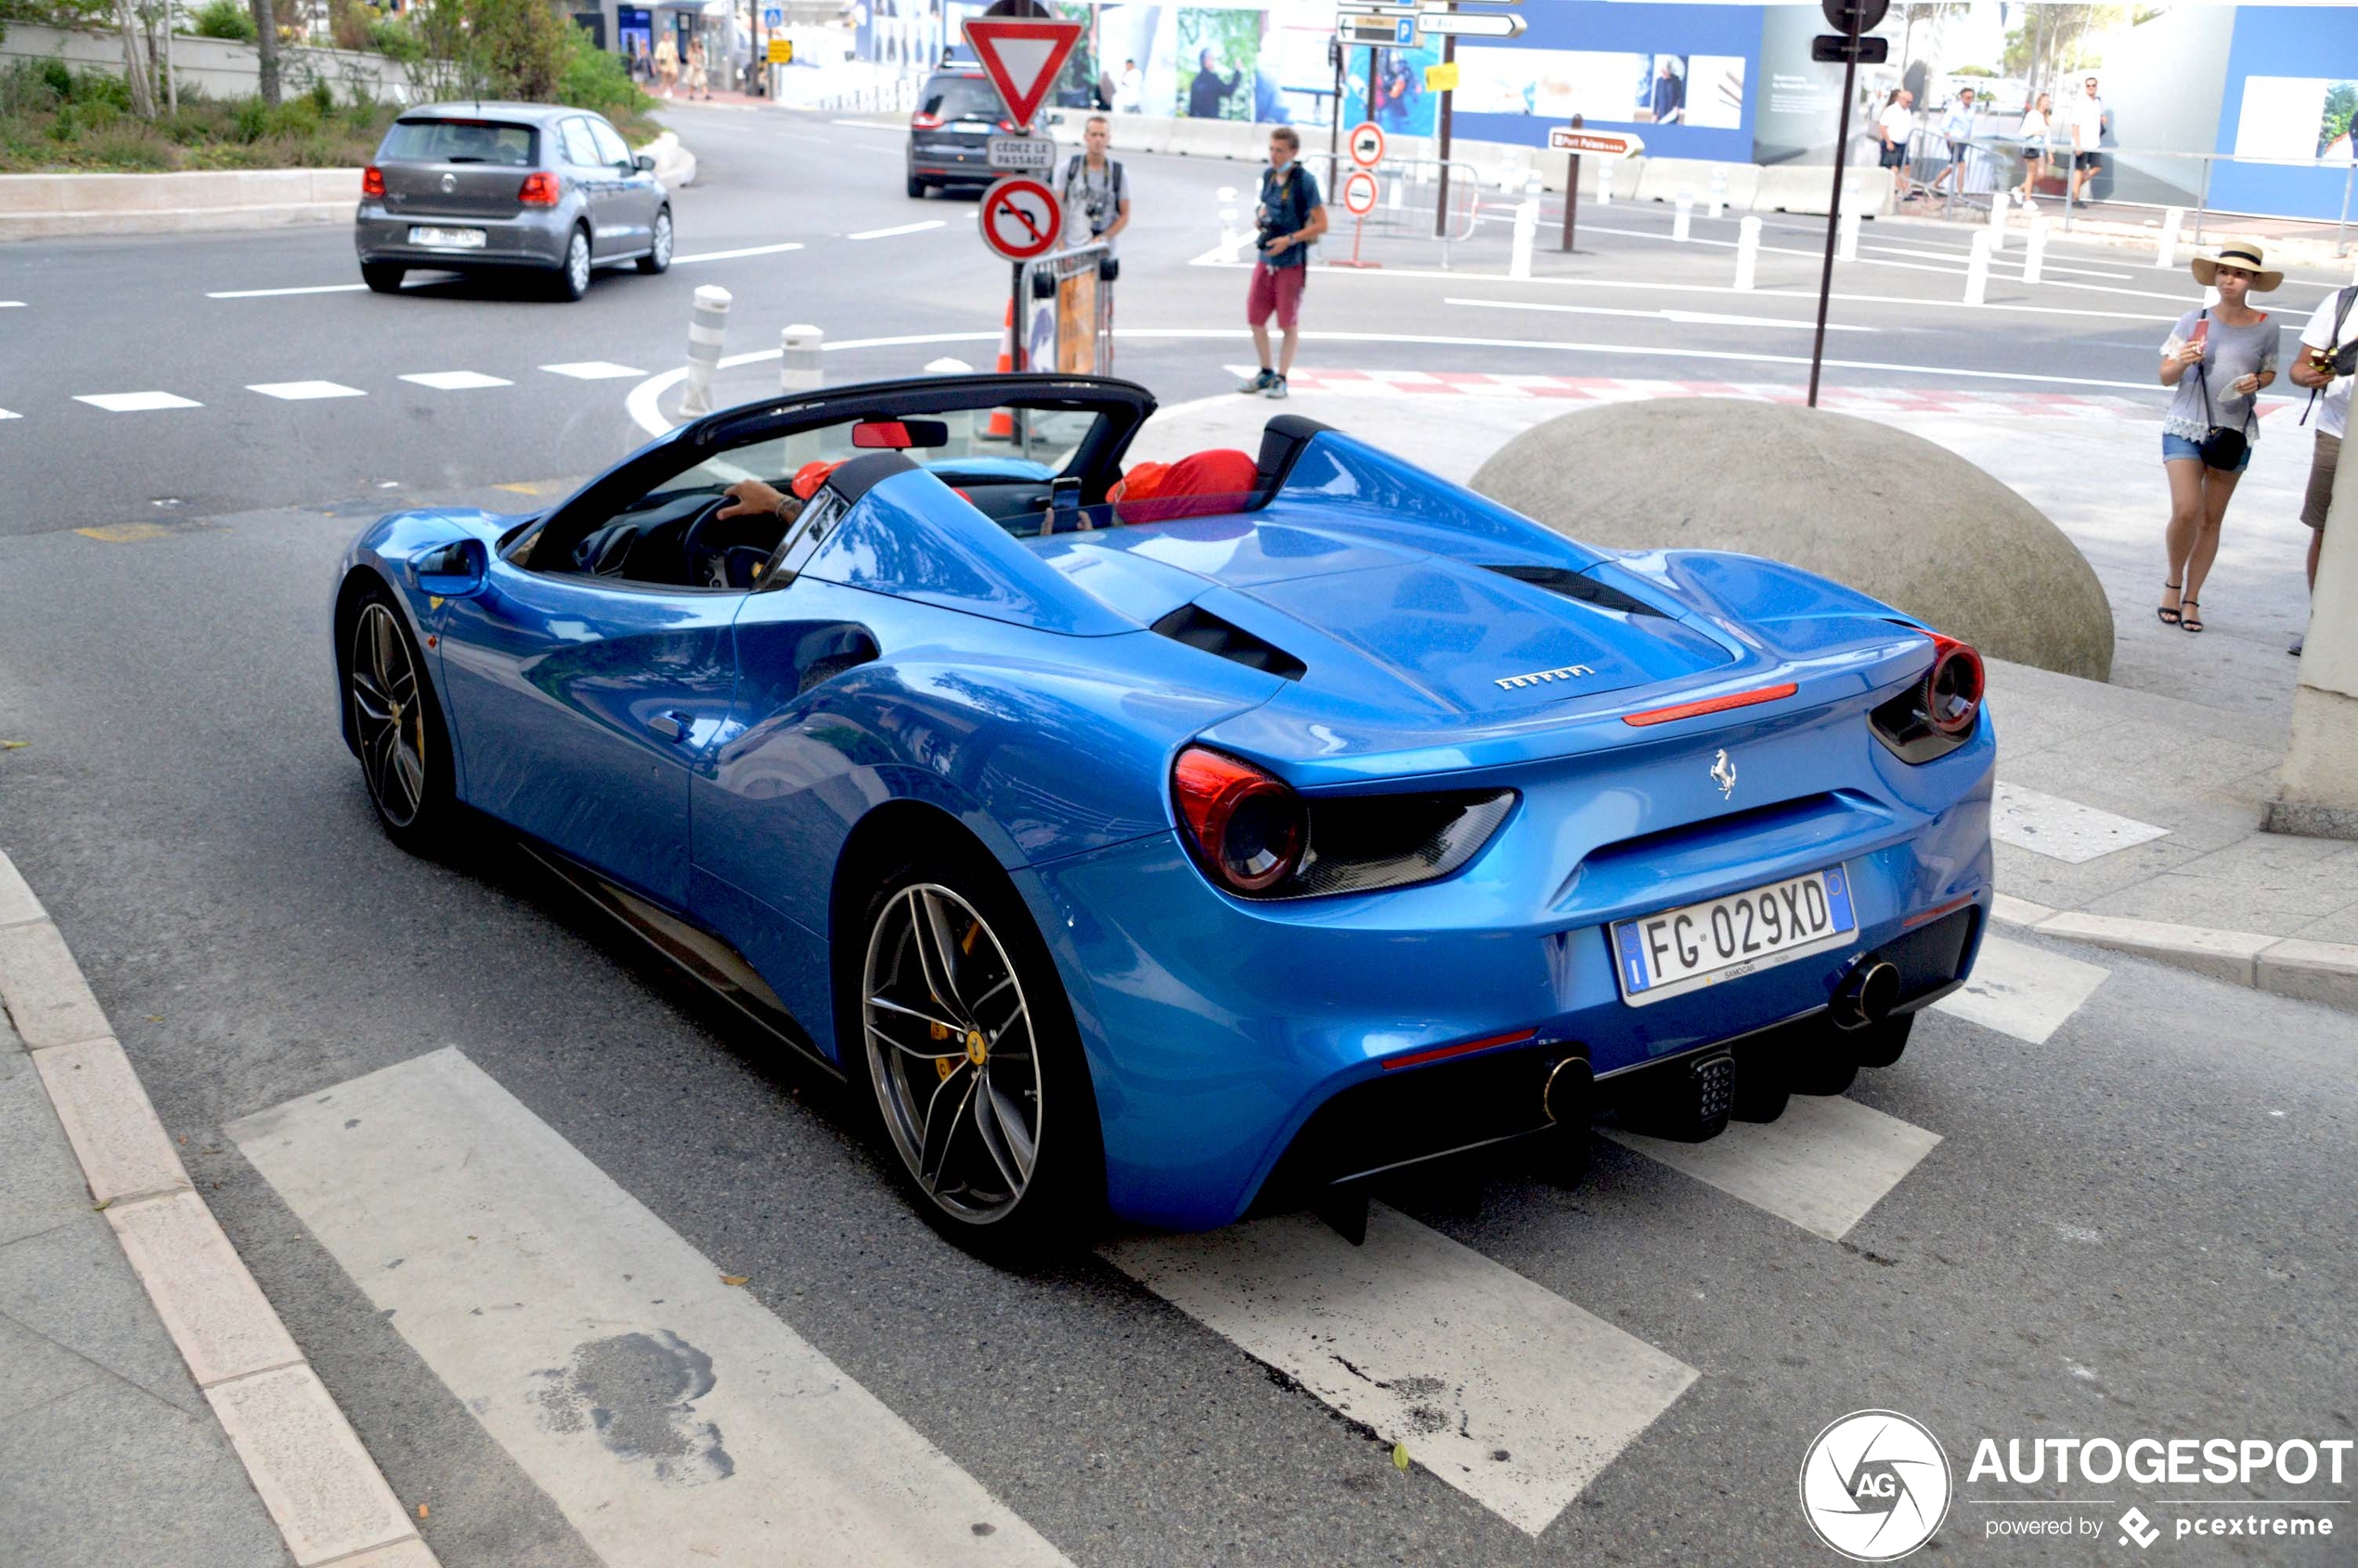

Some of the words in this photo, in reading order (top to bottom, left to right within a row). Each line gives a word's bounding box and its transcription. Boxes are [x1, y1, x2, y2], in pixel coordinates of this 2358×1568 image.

[1400, 22, 1409, 40] P
[996, 142, 1030, 153] CÉDEZ
[1035, 144, 1047, 154] LE
[997, 155, 1044, 164] PASSAGE
[1494, 665, 1596, 690] Ferrari
[1724, 964, 1756, 979] SAMOCAR
